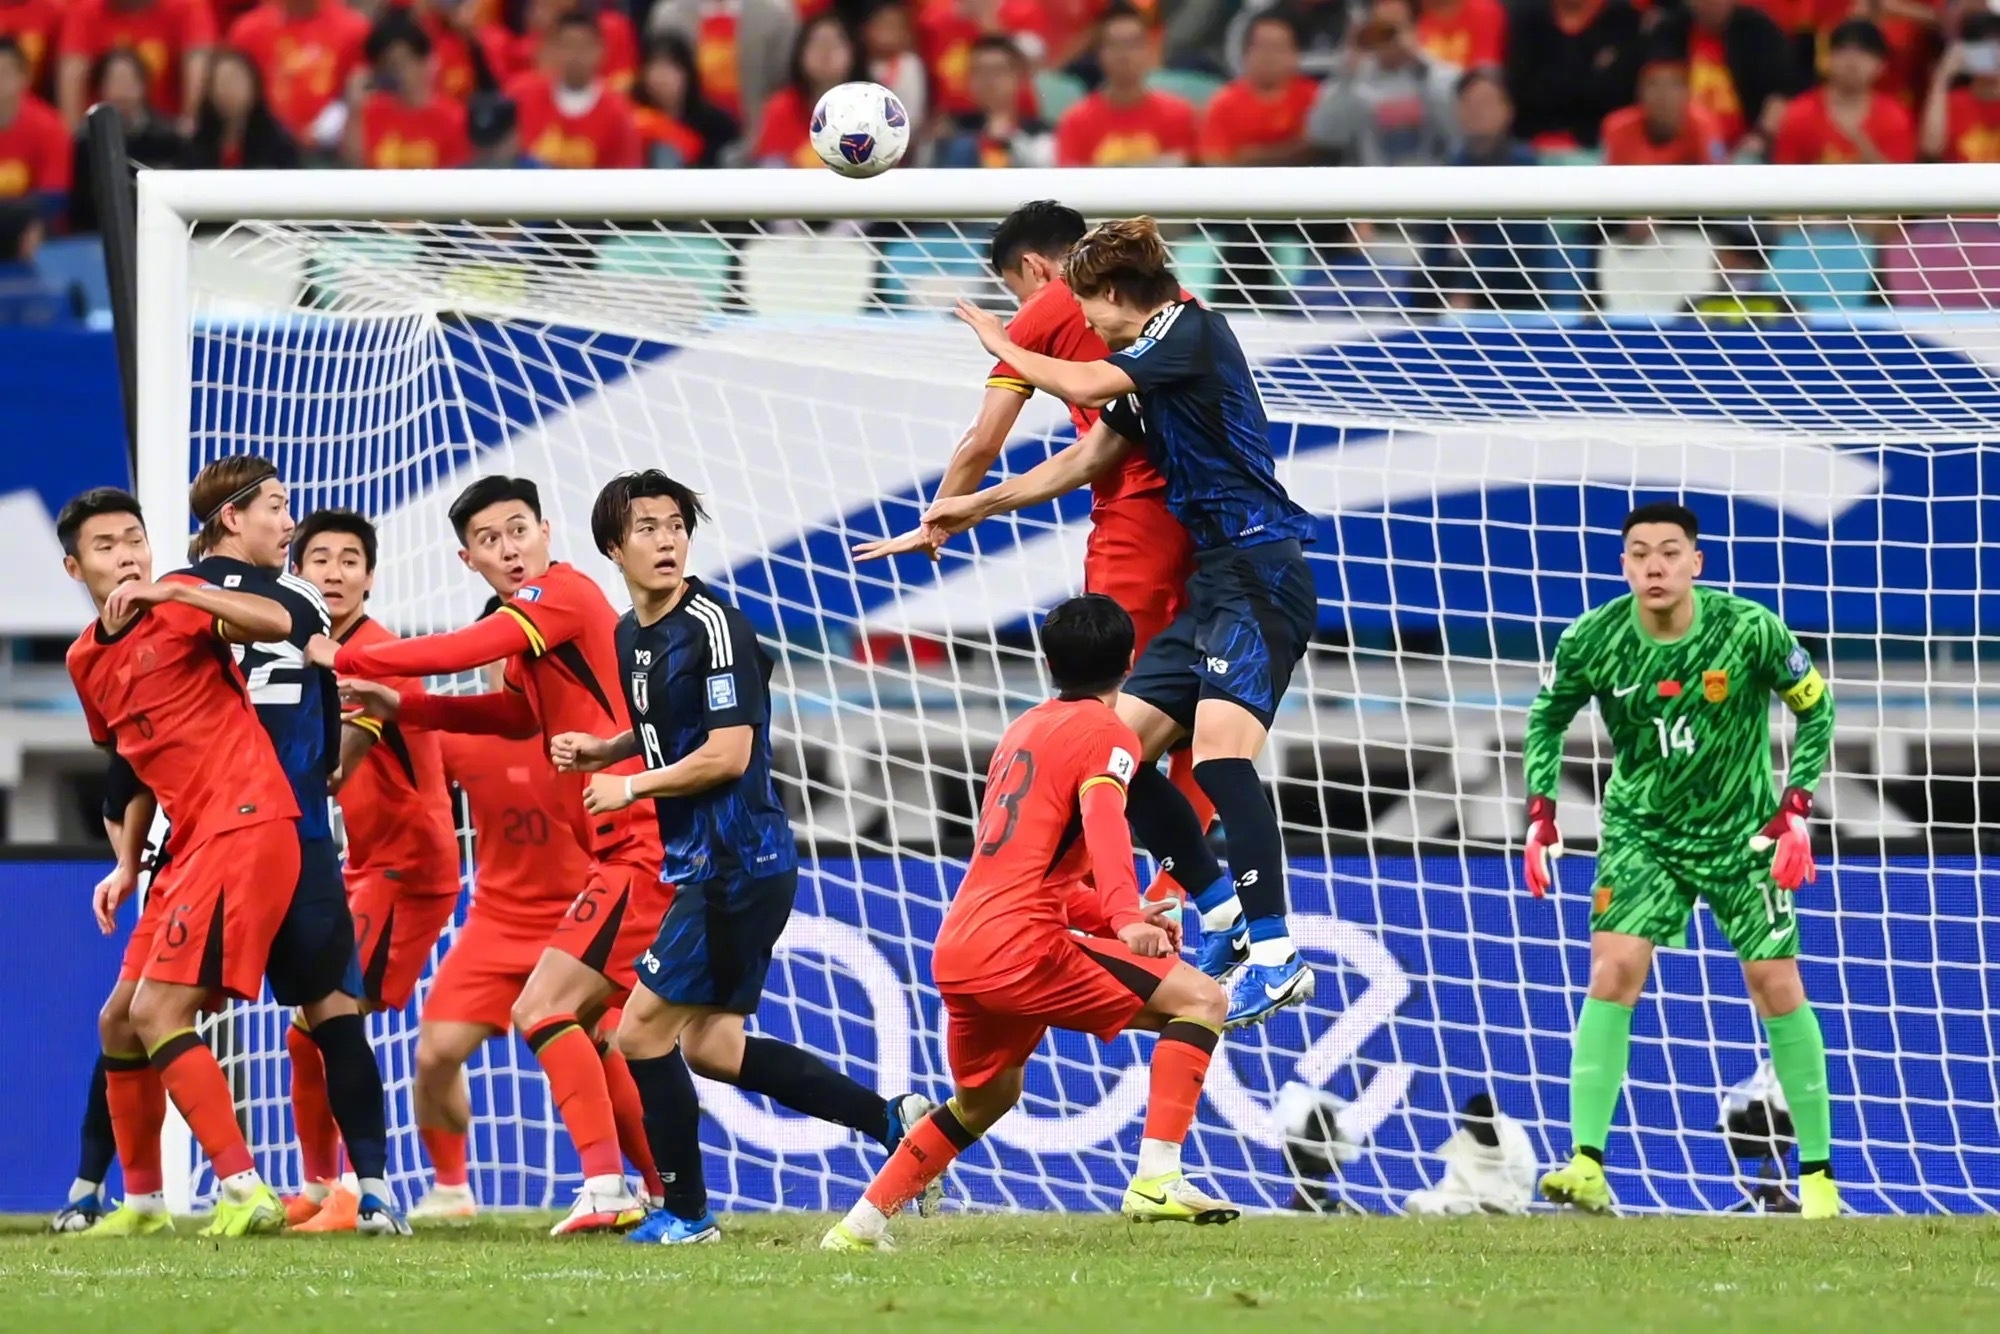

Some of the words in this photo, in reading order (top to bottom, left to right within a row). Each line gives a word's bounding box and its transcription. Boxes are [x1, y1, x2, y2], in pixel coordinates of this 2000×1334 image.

[231, 640, 304, 704] 2
[640, 722, 667, 769] 19
[1653, 716, 1696, 759] 14
[504, 807, 549, 846] 20
[1756, 883, 1796, 924] 14
[167, 904, 191, 947] 6
